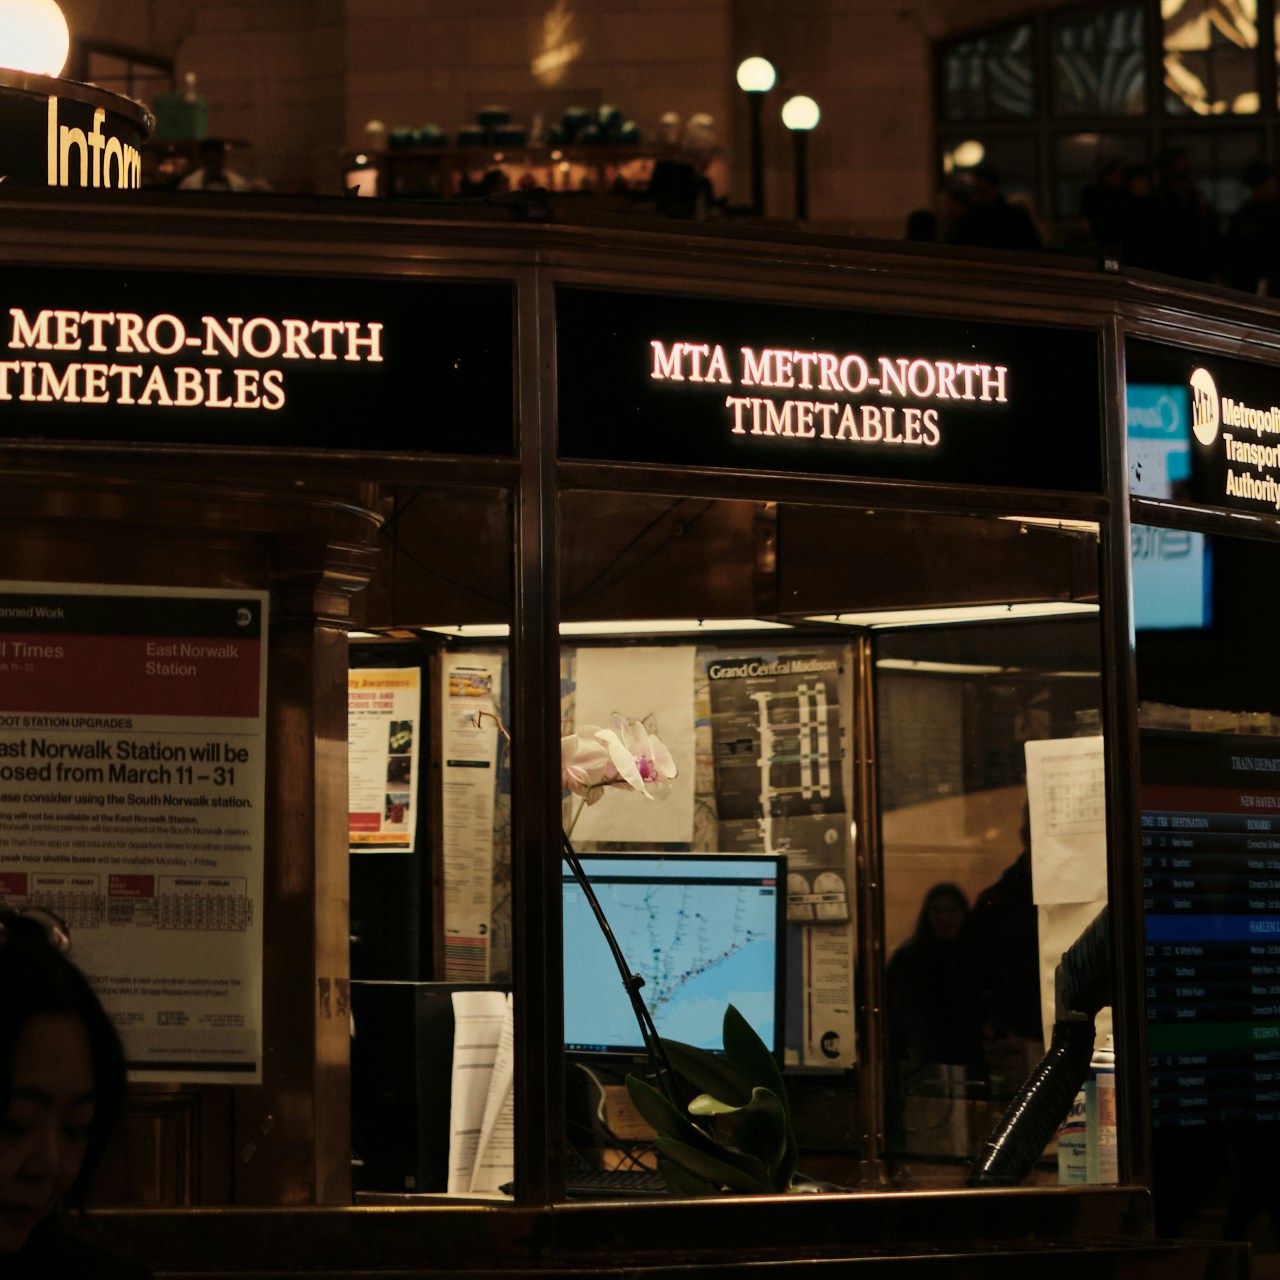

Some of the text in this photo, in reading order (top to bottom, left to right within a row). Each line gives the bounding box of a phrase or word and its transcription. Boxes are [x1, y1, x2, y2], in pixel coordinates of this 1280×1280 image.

[8, 307, 385, 363] METRO-NORTH
[650, 340, 1008, 403] MTA METRO-NORTH
[725, 395, 941, 446] TIMETABLES
[35, 607, 65, 620] Work
[11, 641, 65, 659] Times
[146, 642, 239, 660] East Norwalk
[146, 661, 197, 677] Station
[709, 662, 748, 680] Grand
[748, 659, 791, 678] Central
[23, 716, 70, 729] STATION
[71, 718, 133, 730] UPGRADES
[30, 738, 112, 760] Norwalk
[116, 740, 187, 762] Station
[189, 742, 222, 762] will
[224, 743, 250, 764] be
[56, 762, 104, 783] from
[108, 764, 171, 785] March
[175, 766, 194, 785] 11
[212, 767, 236, 786] 31
[23, 791, 73, 804] consider
[74, 792, 105, 807] using
[107, 793, 125, 805] the
[127, 793, 162, 807] South
[163, 794, 210, 808] Norwalk
